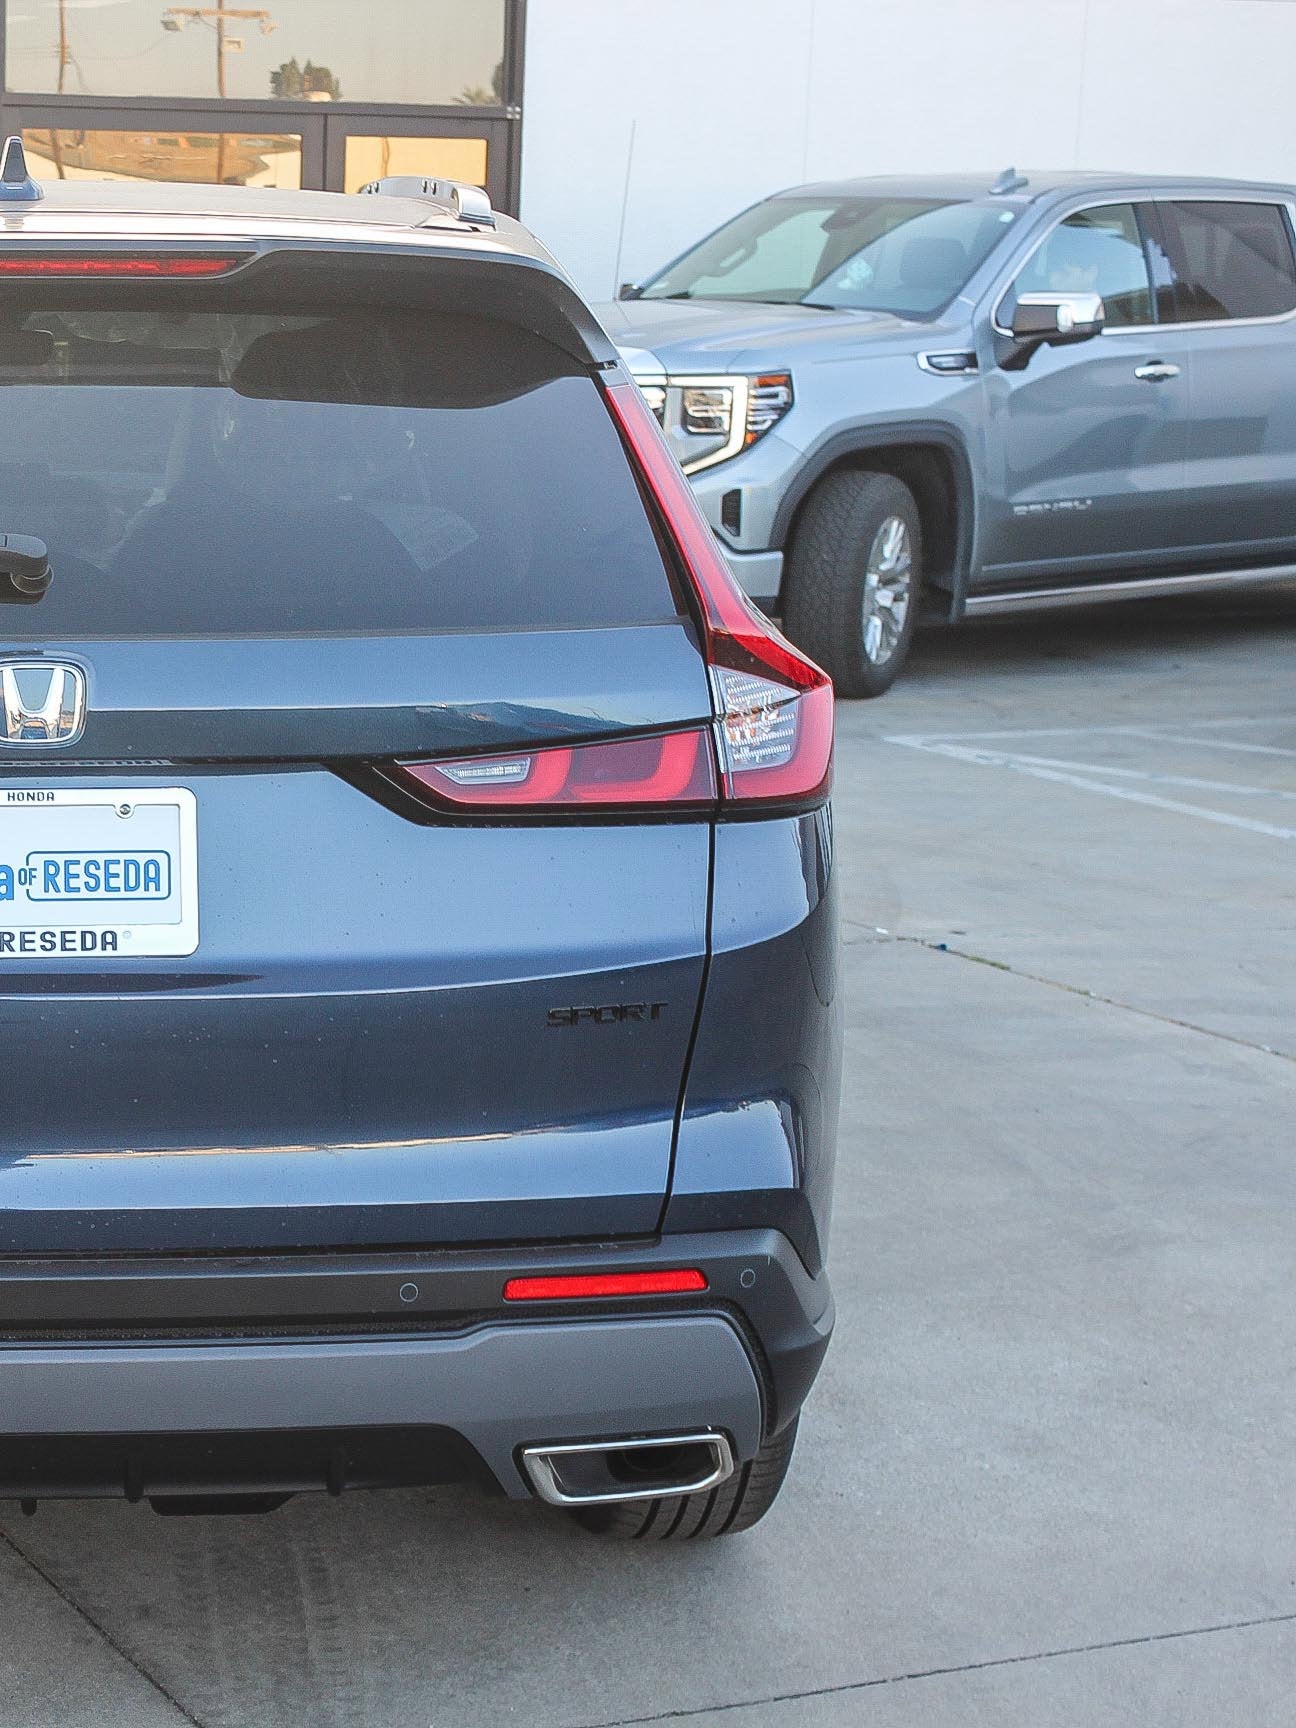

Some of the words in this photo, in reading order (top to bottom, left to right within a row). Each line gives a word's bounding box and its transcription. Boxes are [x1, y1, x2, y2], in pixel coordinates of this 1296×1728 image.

[7, 792, 55, 801] HONDA
[18, 868, 38, 886] OF
[43, 859, 161, 893] RESEDA
[546, 1003, 669, 1026] SPORT
